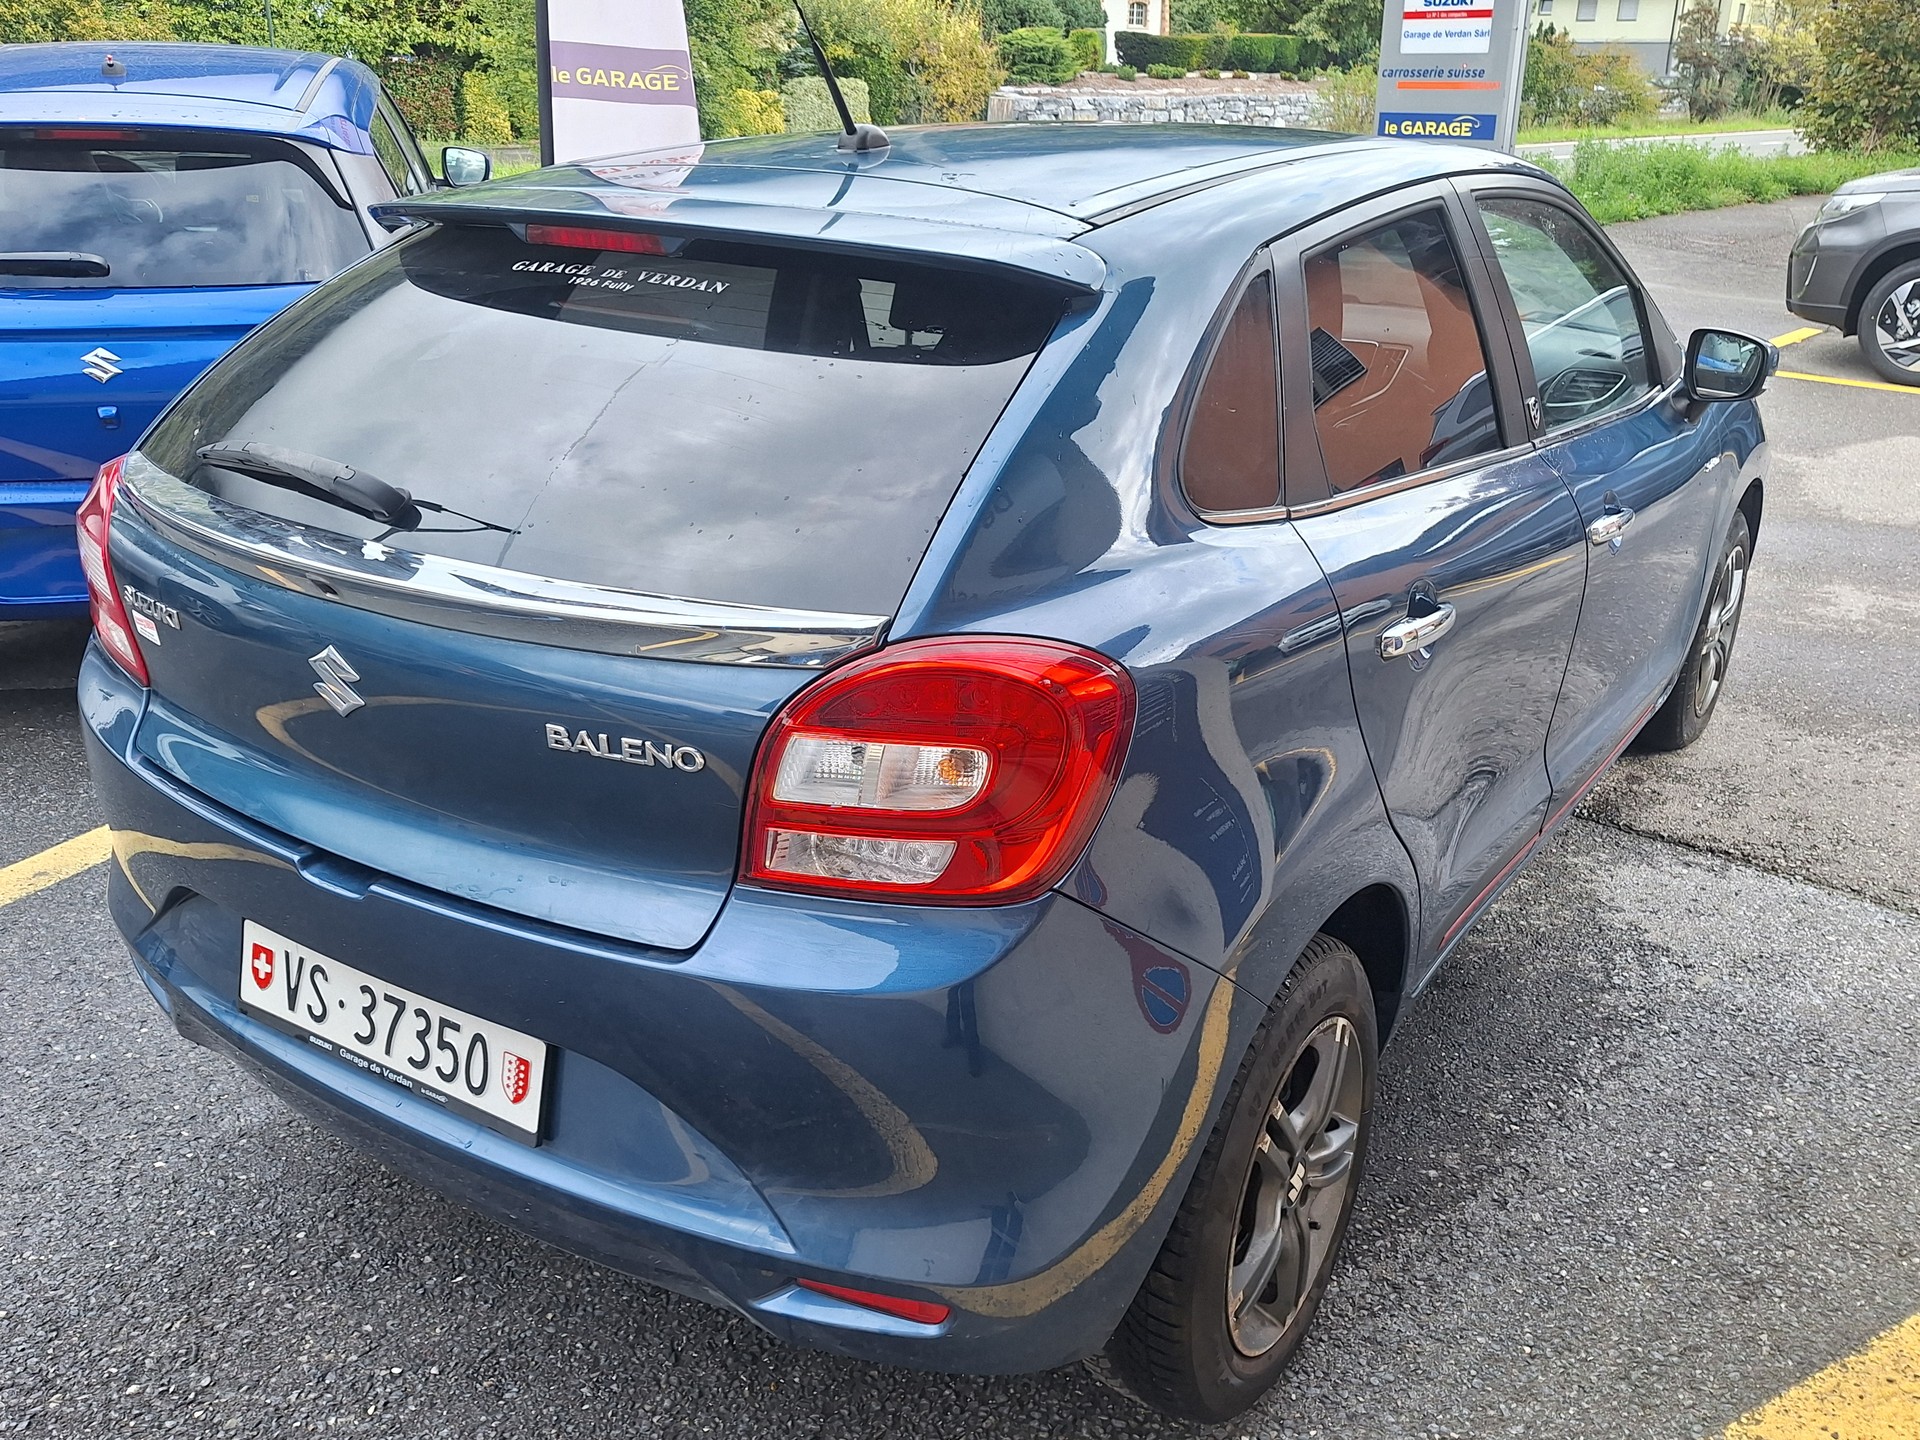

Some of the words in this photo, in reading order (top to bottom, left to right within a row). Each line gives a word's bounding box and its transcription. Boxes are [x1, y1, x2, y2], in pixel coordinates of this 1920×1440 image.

[1403, 30, 1431, 40] Garage
[1433, 30, 1442, 38] de
[1444, 29, 1472, 38] Verdan
[551, 65, 571, 84] le
[575, 67, 680, 91] GARAGE
[1382, 65, 1444, 78] carrosserie
[1447, 63, 1485, 78] suisse
[1384, 120, 1398, 135] le
[1400, 120, 1473, 136] GARAGE
[511, 260, 596, 276] GARAGE
[600, 268, 627, 280] DE
[638, 270, 731, 295] VERDAN
[568, 276, 600, 288] 1926
[600, 279, 635, 293] Fully
[123, 584, 182, 631] SUZUKI
[545, 723, 707, 773] BALENO
[339, 1048, 369, 1068] Garage
[369, 1063, 381, 1074] de
[382, 1067, 413, 1088] Verdan
